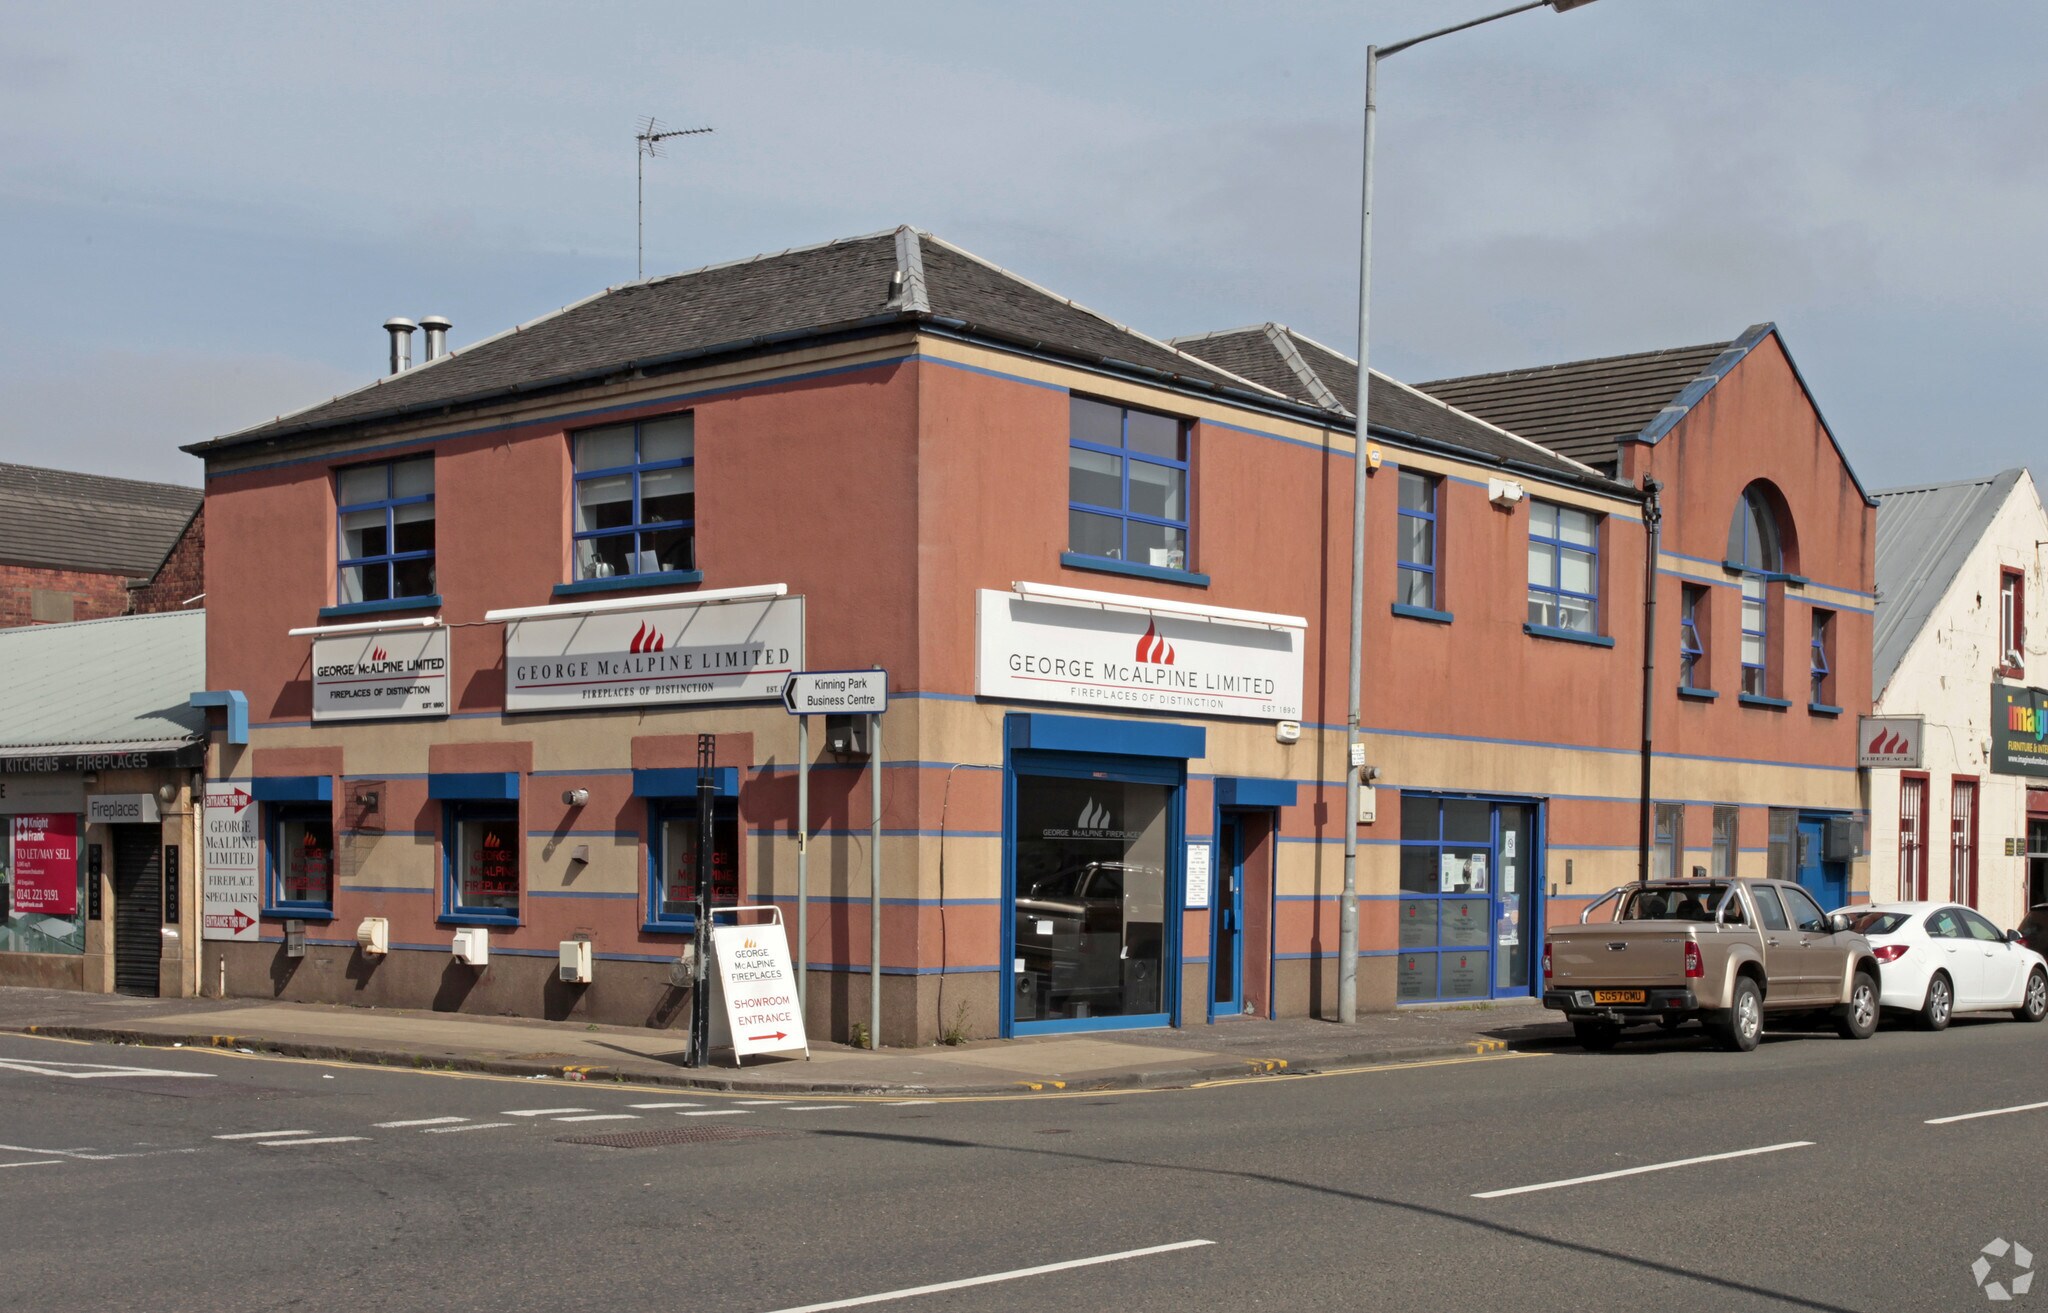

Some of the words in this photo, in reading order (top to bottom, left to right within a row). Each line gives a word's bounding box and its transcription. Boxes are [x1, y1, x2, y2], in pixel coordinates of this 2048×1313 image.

[317, 664, 354, 677] GEORGE
[358, 660, 403, 674] McALPINE
[407, 658, 444, 671] LIMITED
[517, 662, 588, 680] GEORGE
[597, 654, 693, 675] McALPINE
[702, 648, 789, 668] LIMITED
[1009, 654, 1094, 678] GEORGE
[1104, 663, 1197, 688] McALPINE
[1206, 673, 1275, 695] LIMITED
[582, 686, 634, 699] FIREPLACES
[639, 686, 650, 695] OF
[655, 682, 714, 695] DISTINCTION
[815, 678, 846, 691] Kinning
[848, 678, 867, 689] Park
[330, 688, 371, 699] FIREPLACES
[374, 687, 383, 697] OF
[386, 685, 430, 696] DISTINCTION
[1070, 687, 1138, 701] FIREPLACES
[1142, 693, 1155, 702] OF
[1159, 695, 1224, 709] DISTINCTION
[807, 695, 845, 706] Business
[847, 694, 875, 705] Centre
[1262, 704, 1276, 713] EST
[1279, 706, 1296, 714] 1890
[2008, 740, 2033, 752] FURNITURE
[6, 756, 59, 773] KITCHENS
[76, 753, 148, 771] FIREPLACES
[206, 795, 228, 807] ENTRANCE
[229, 794, 239, 807] THIS
[238, 794, 248, 806] WAY
[91, 801, 139, 820] Fireplaces
[28, 817, 49, 831] Knight
[210, 820, 251, 833] GEORGE
[28, 830, 45, 841] Frank
[1042, 828, 1069, 837] GEORGE
[1072, 829, 1103, 838] McALPINE
[205, 836, 257, 849] McALPINE
[16, 848, 26, 860] TO
[55, 847, 71, 860] SELL
[208, 851, 254, 865] LIMITED
[208, 875, 255, 887] FIREPLACE
[16, 888, 31, 900] 0141
[31, 888, 43, 900] 221
[43, 889, 59, 901] 9191
[205, 892, 258, 903] SPECIALISTS
[206, 916, 228, 928] ENTRANCE
[229, 916, 239, 928] THIS
[238, 916, 248, 928] WAY
[735, 948, 769, 959] GEORGE
[731, 969, 782, 981] FIREPLACES
[733, 995, 790, 1009] SHOWROOM
[1599, 991, 1622, 1001] SG57
[1624, 991, 1641, 1001] GMU
[738, 1011, 792, 1026] ENTRANCE
